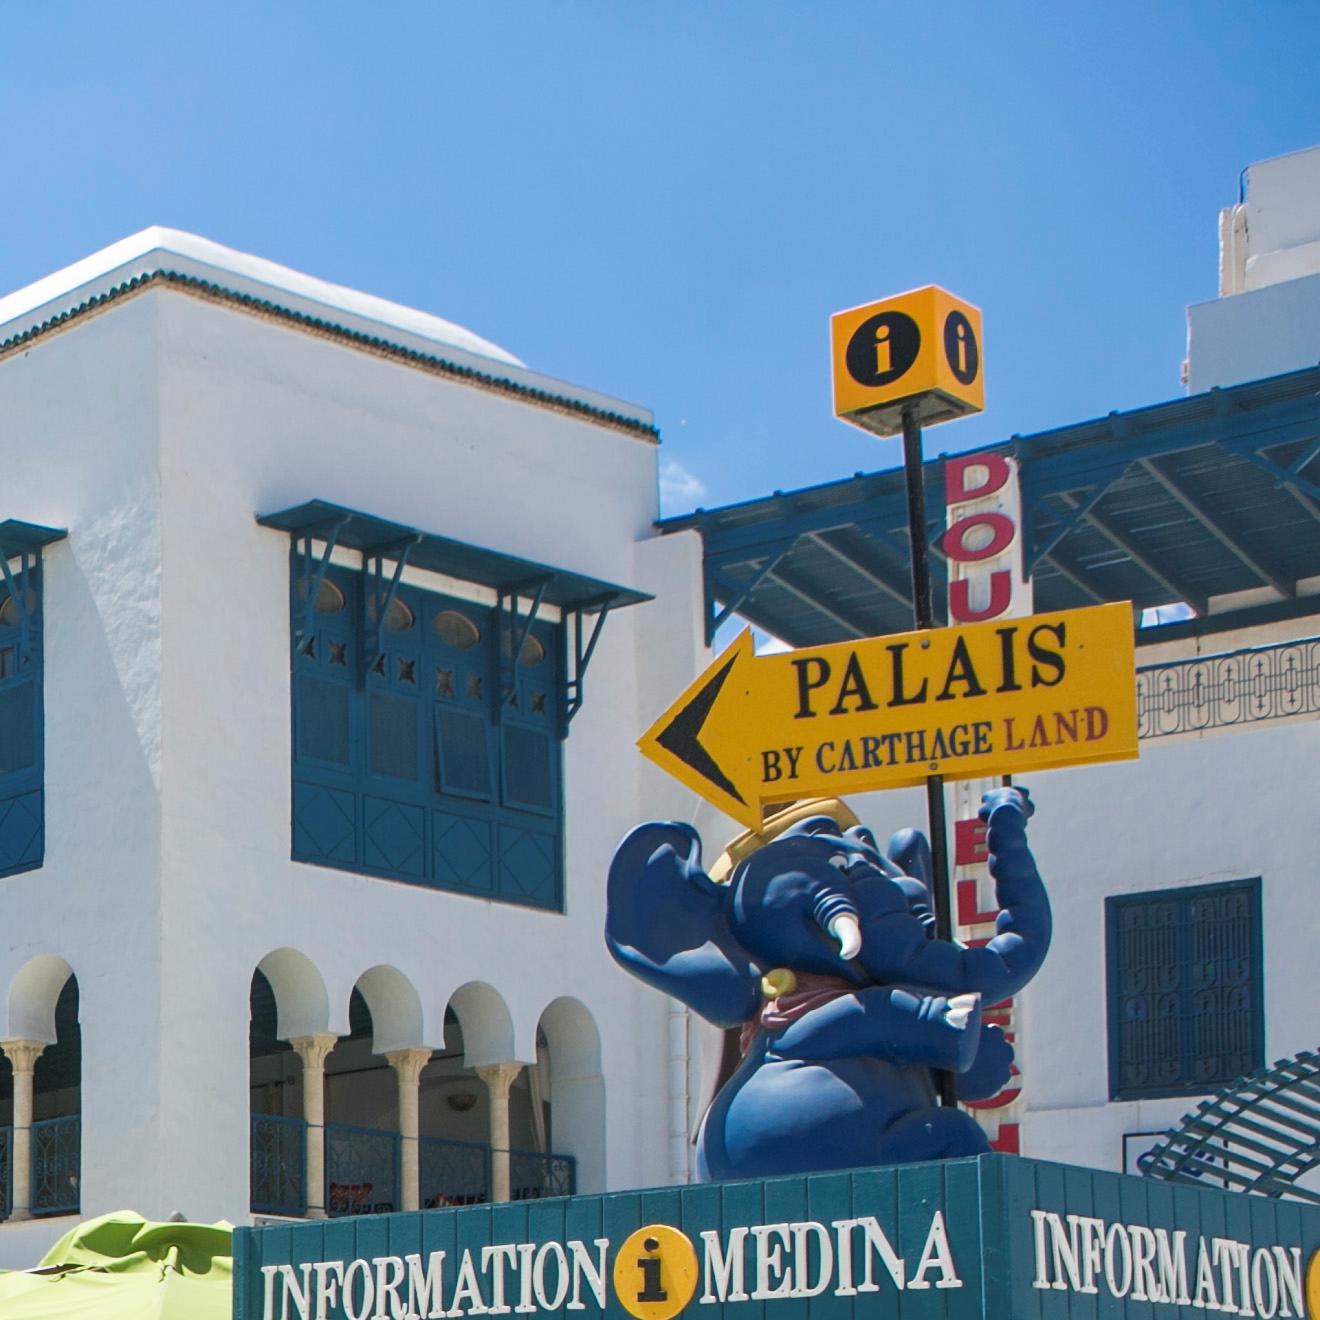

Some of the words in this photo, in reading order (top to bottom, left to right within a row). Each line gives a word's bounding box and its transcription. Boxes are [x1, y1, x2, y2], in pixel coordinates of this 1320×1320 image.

[791, 620, 1069, 720] PALAIS
[761, 746, 801, 784] BY
[815, 720, 994, 775] CARTHAGE
[1003, 705, 1109, 751] LAND
[696, 1208, 963, 1306] MEDINA
[1030, 1208, 1305, 1320] INFORMATION
